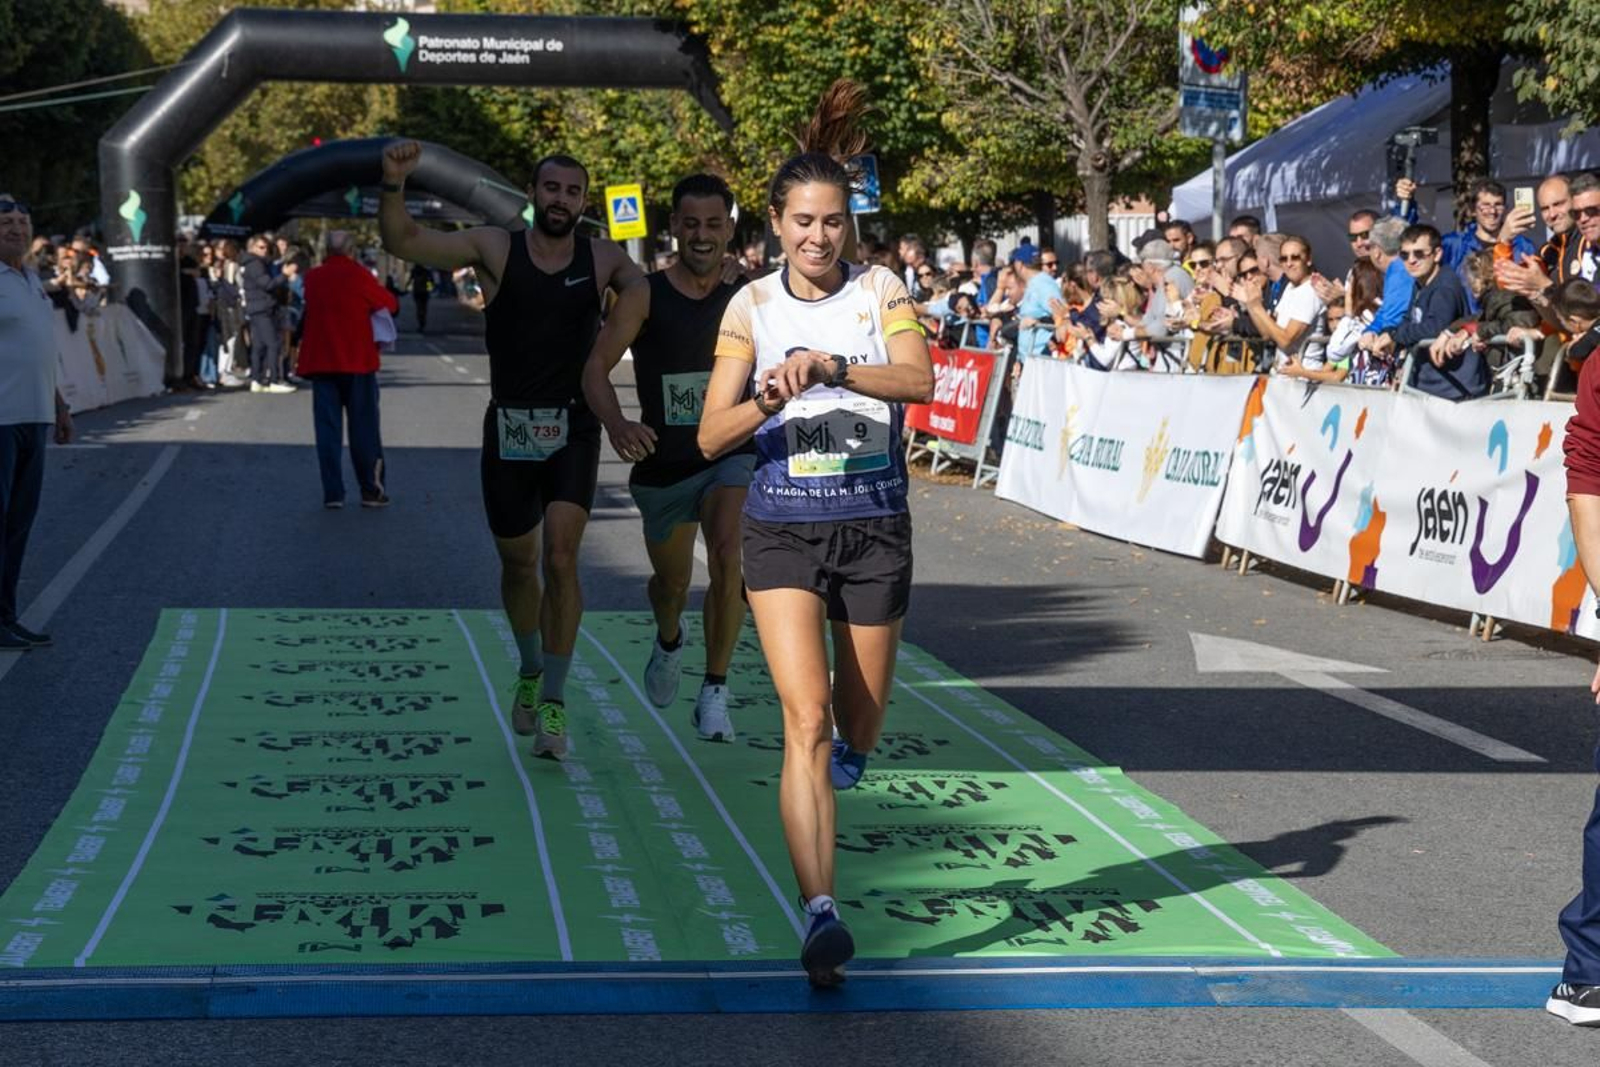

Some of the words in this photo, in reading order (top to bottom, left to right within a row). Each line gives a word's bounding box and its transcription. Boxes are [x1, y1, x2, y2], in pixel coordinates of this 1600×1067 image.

[418, 36, 480, 50] Patronato
[482, 37, 543, 53] Municipal
[546, 39, 564, 52] de
[418, 50, 476, 64] Deportes
[479, 51, 497, 64] de
[499, 50, 530, 64] Jaén
[533, 425, 561, 438] 739
[854, 421, 868, 438] 9
[776, 486, 807, 497] MAGIA
[810, 487, 822, 498] DE
[824, 488, 837, 497] LA
